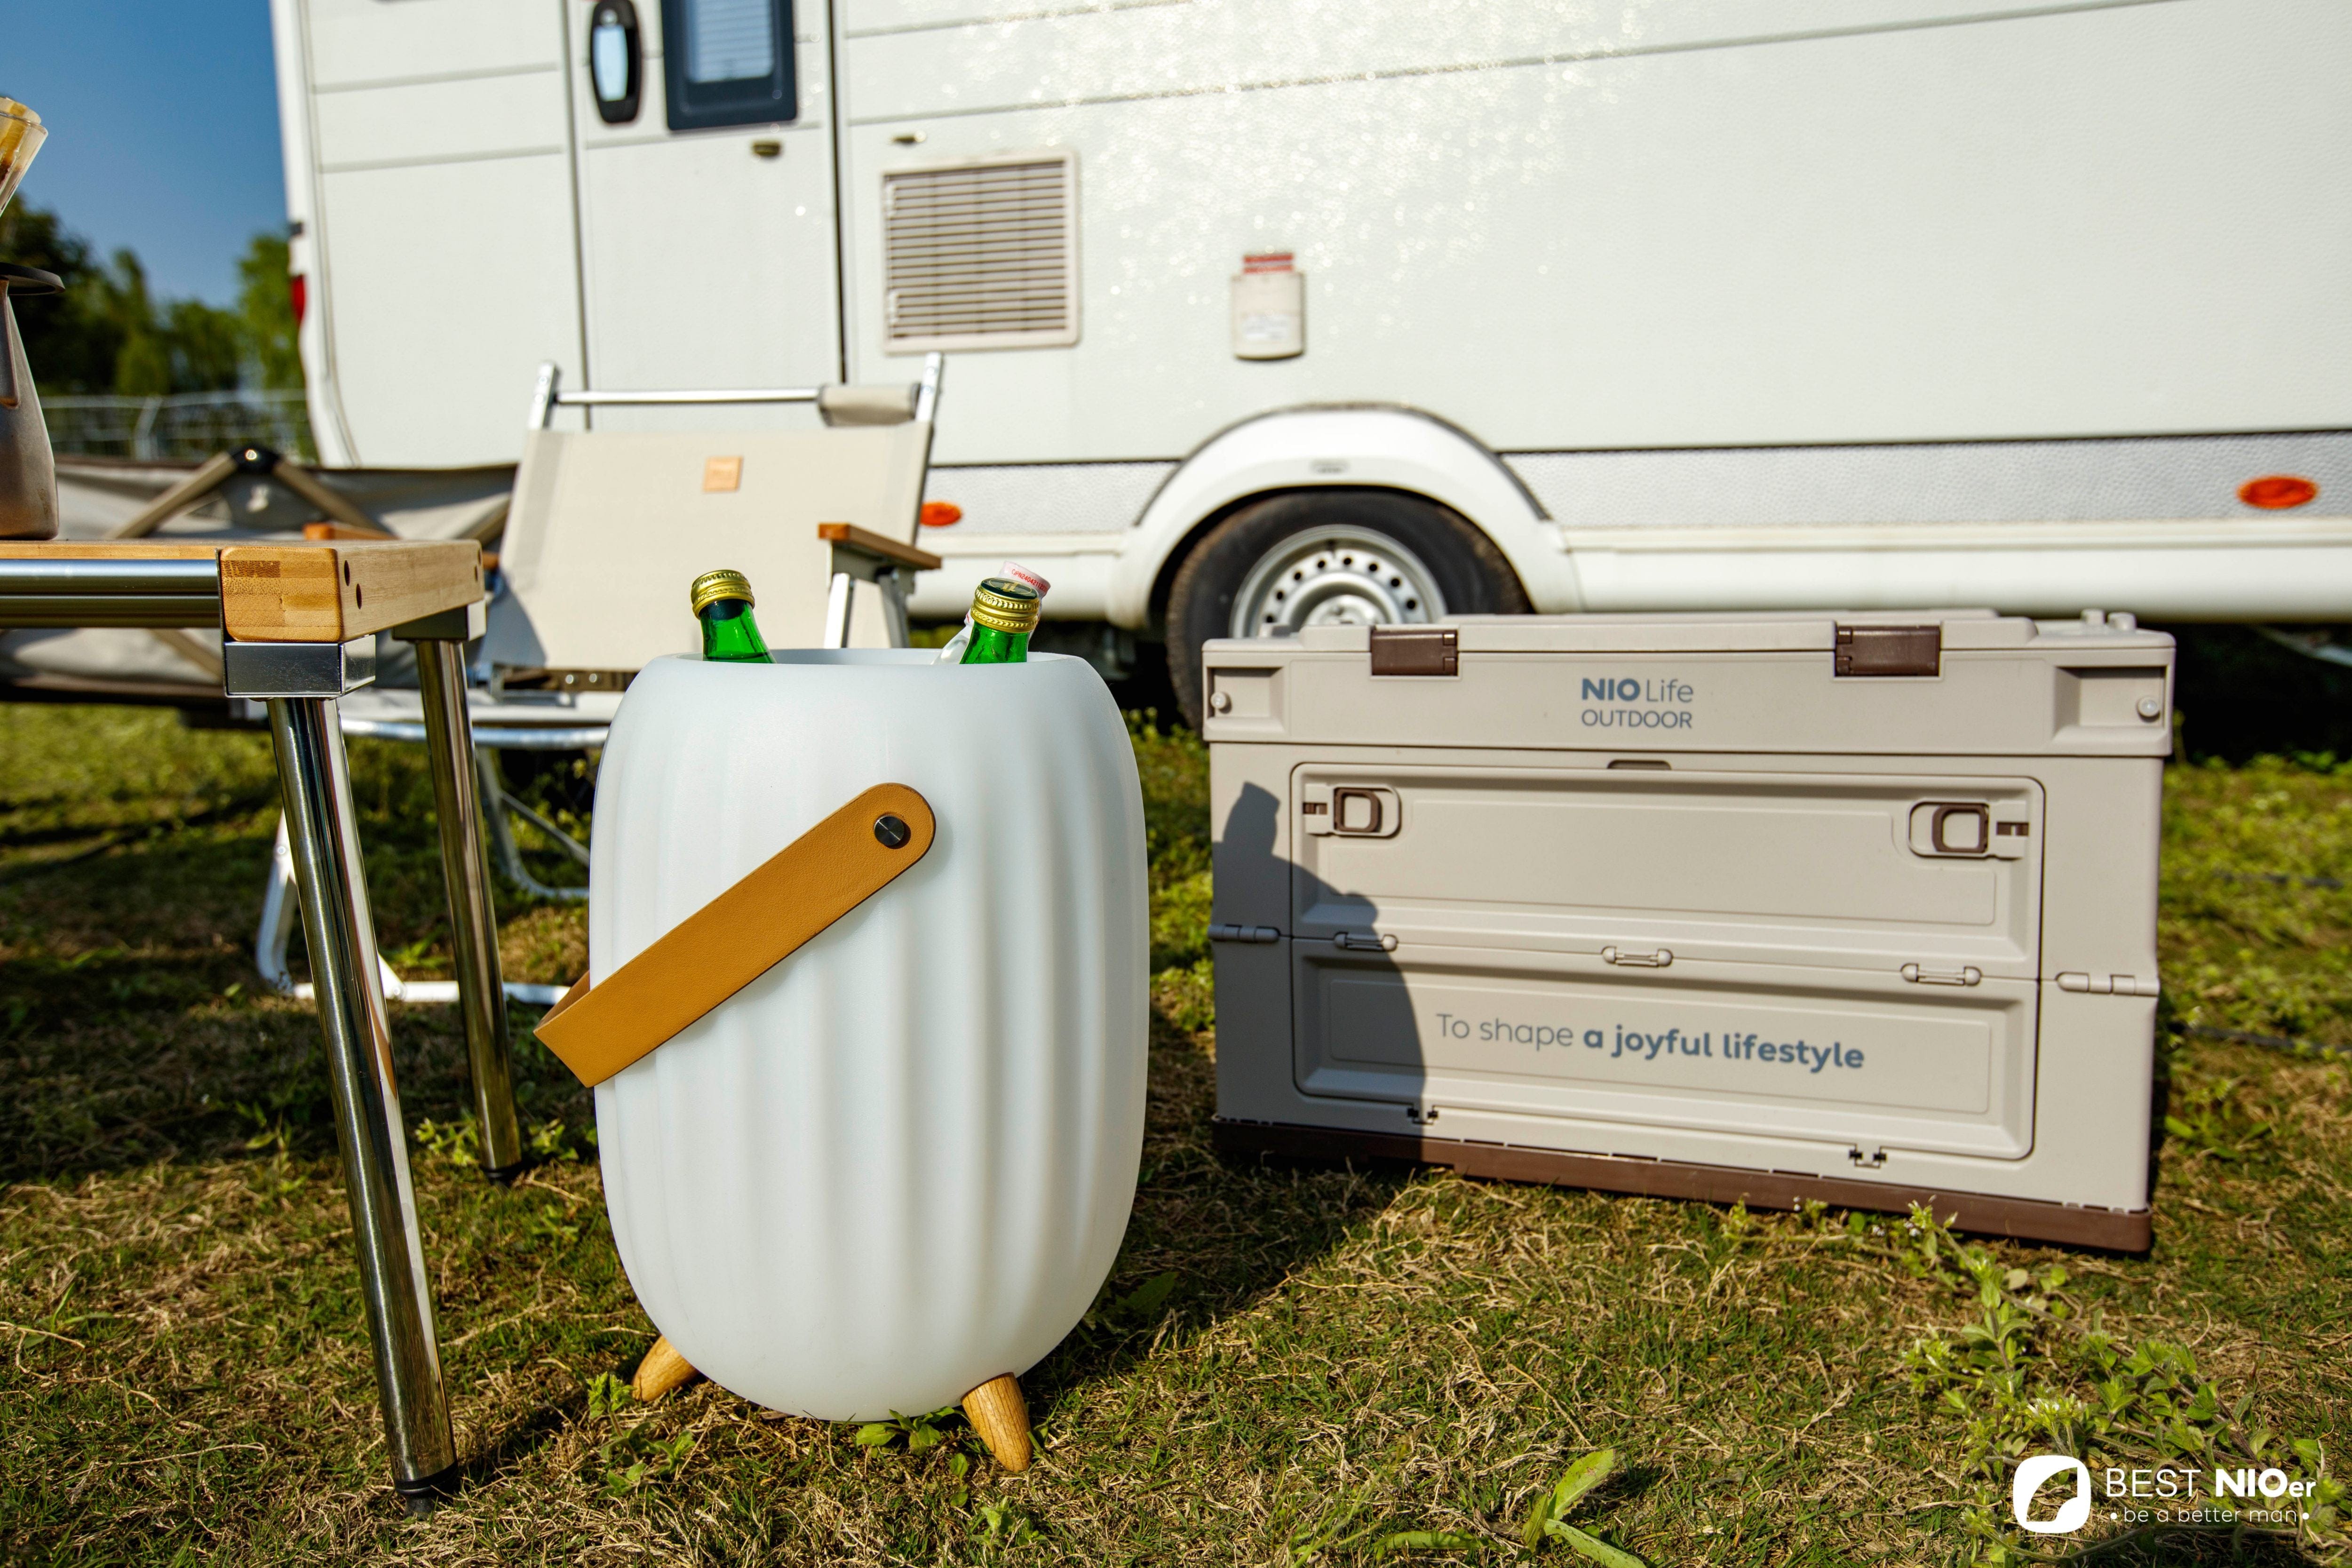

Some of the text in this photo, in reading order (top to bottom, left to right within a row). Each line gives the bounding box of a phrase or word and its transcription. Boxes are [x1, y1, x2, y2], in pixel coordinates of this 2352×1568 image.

[1581, 678, 1693, 703] NIO Life
[1581, 709, 1692, 729] OUTDOOR
[1436, 1013, 1865, 1074] To shape a joyful lifestyle
